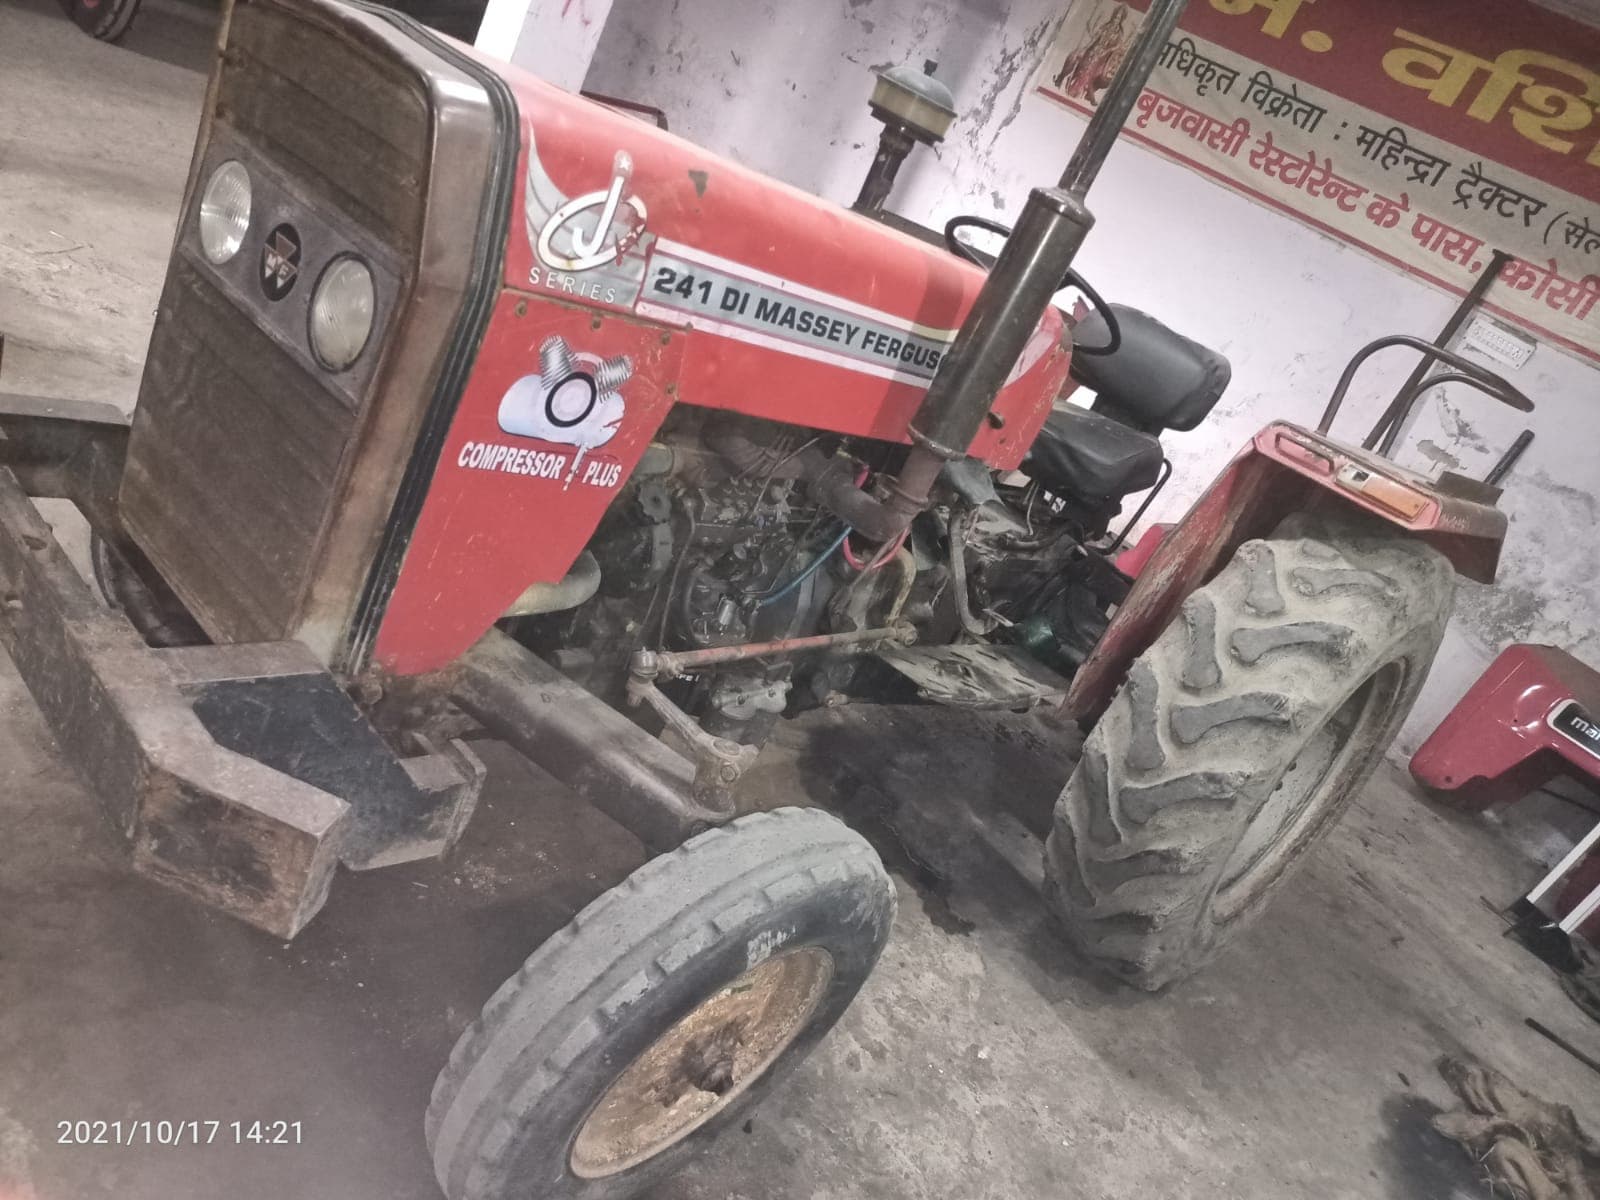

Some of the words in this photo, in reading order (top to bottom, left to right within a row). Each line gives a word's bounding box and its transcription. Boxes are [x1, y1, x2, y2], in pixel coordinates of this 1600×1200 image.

[1136, 87, 1250, 158] बृजवासी
[1249, 131, 1369, 212] रेस्टोरेन्ट
[1366, 192, 1410, 228] के
[1411, 213, 1485, 273] पास,
[1240, 71, 1328, 133] विक्रेता
[1356, 125, 1452, 187] महिन्द्रा
[1452, 162, 1547, 227] ट्रैक्टर
[529, 266, 616, 304] SERIES
[653, 267, 713, 305] 241
[719, 286, 751, 315] DI
[754, 297, 860, 345] MASSEY
[861, 330, 944, 370] FERGUS
[458, 441, 566, 479] COMPRESSOR
[582, 461, 622, 488] PLUS
